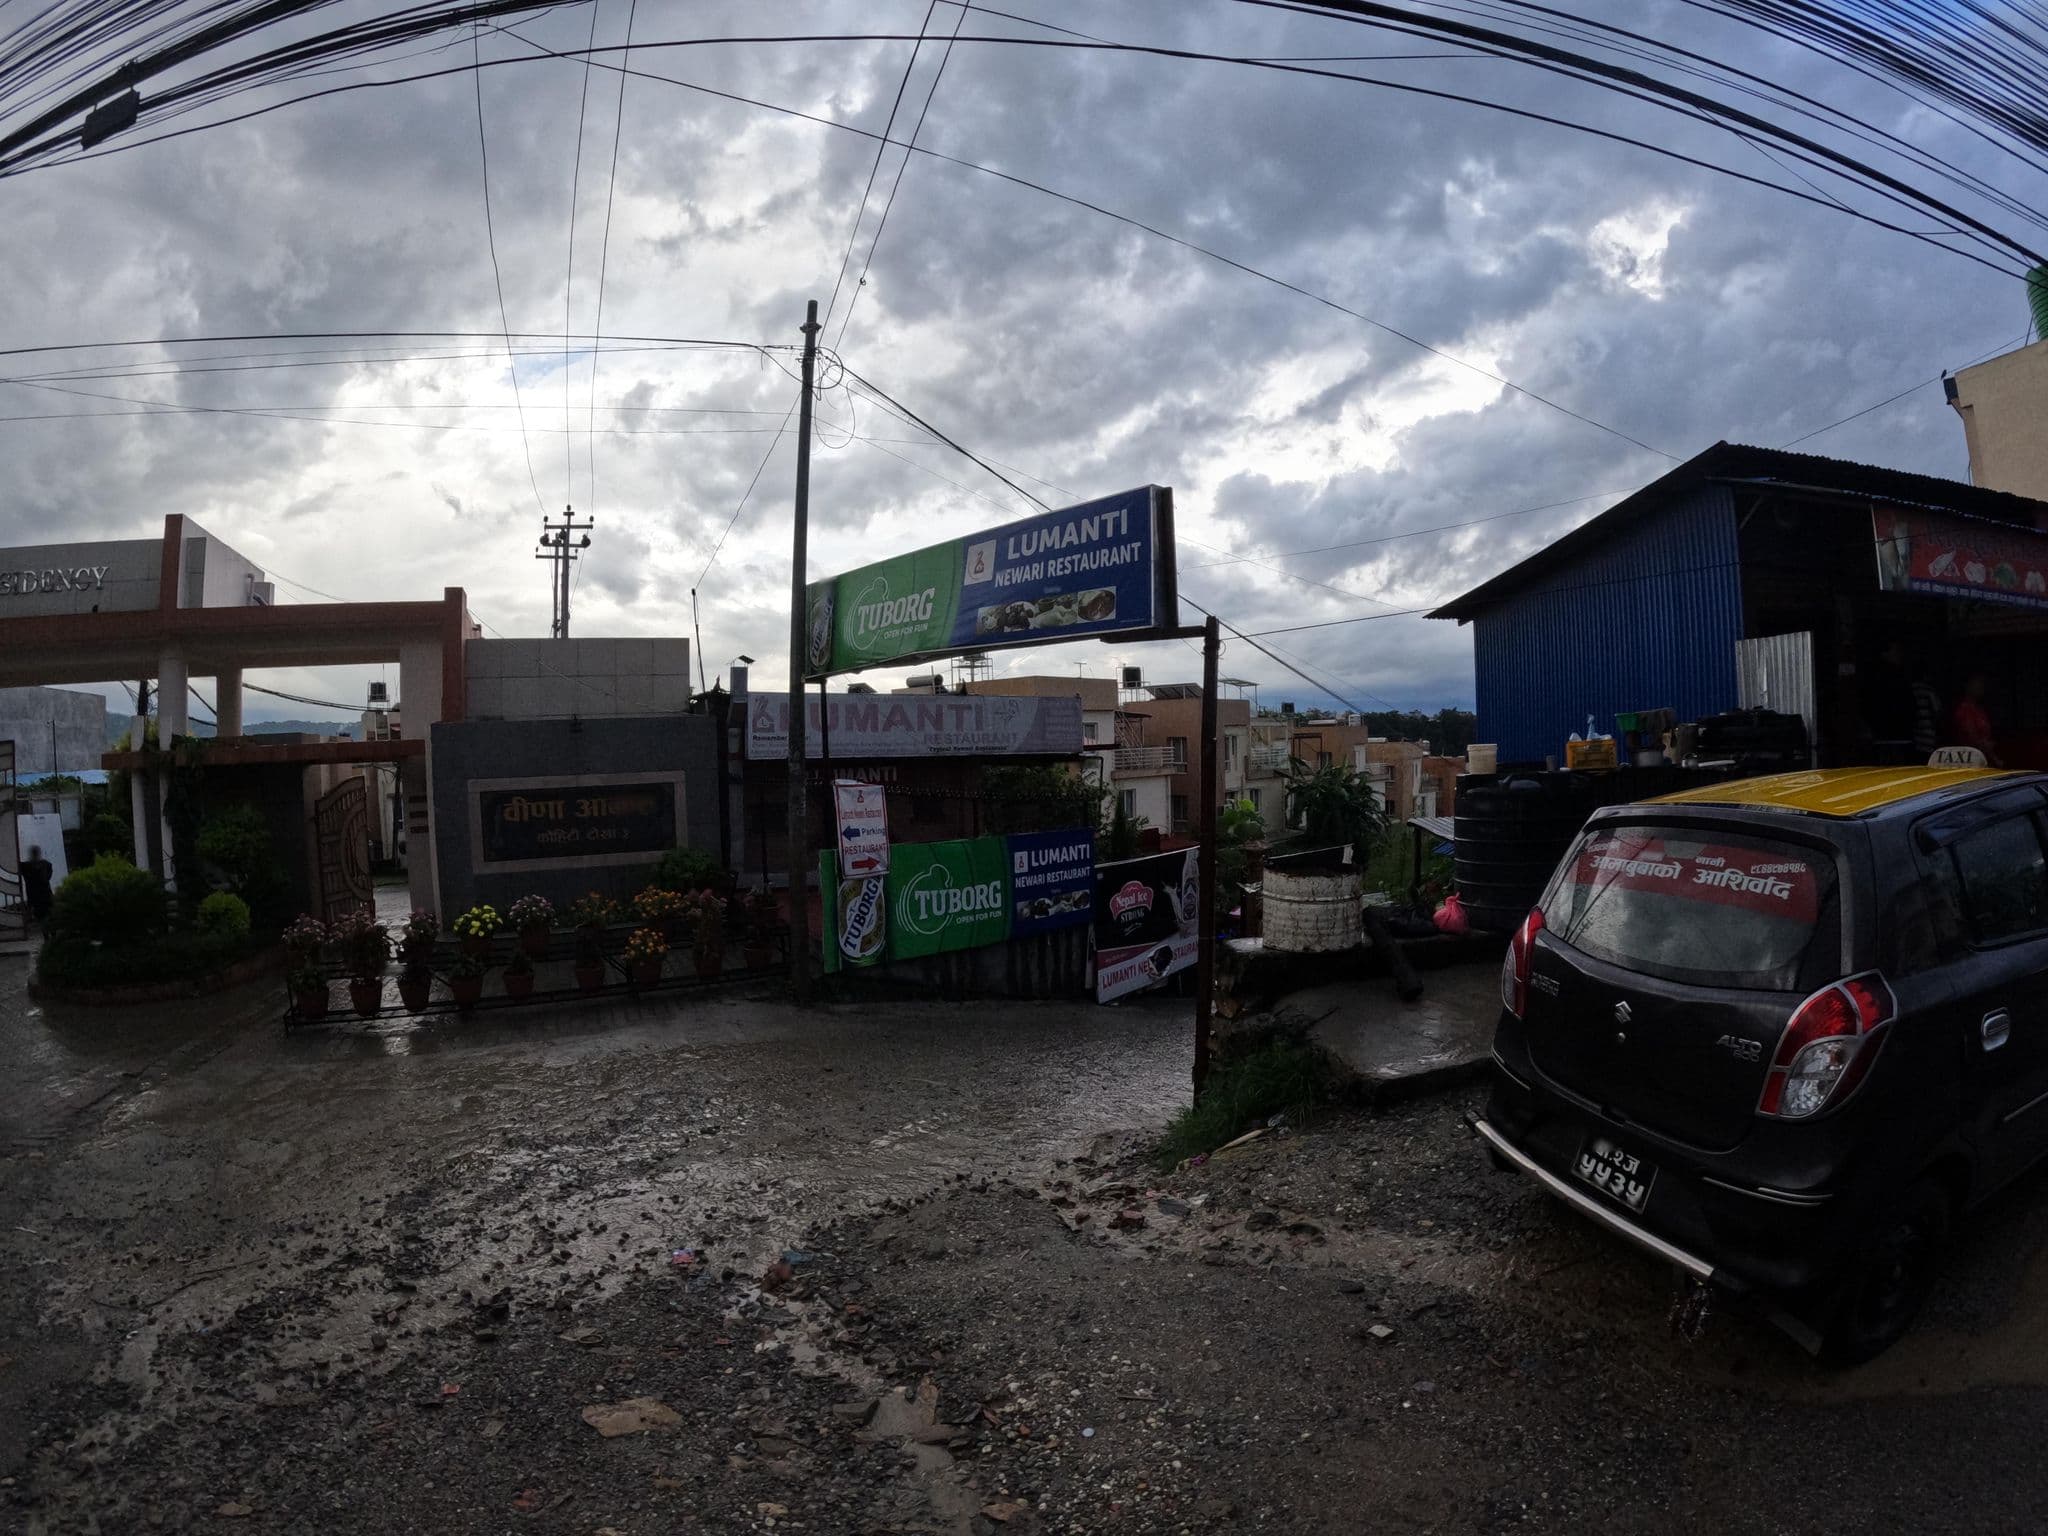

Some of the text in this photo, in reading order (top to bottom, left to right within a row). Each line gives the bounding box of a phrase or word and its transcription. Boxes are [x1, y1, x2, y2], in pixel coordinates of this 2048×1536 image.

[1007, 509, 1128, 560] LUMANTI
[994, 541, 1142, 588] NEWARI RESTAURANT
[857, 587, 936, 636] TUBORG
[1935, 750, 1972, 764] TAXI
[1031, 843, 1090, 867] LUMANTI
[1015, 866, 1091, 888] NEWARI RESTAURANT
[844, 879, 879, 950] TUBORG
[914, 880, 1002, 921] TUBORG
[1102, 963, 1137, 989] LUMANTI
